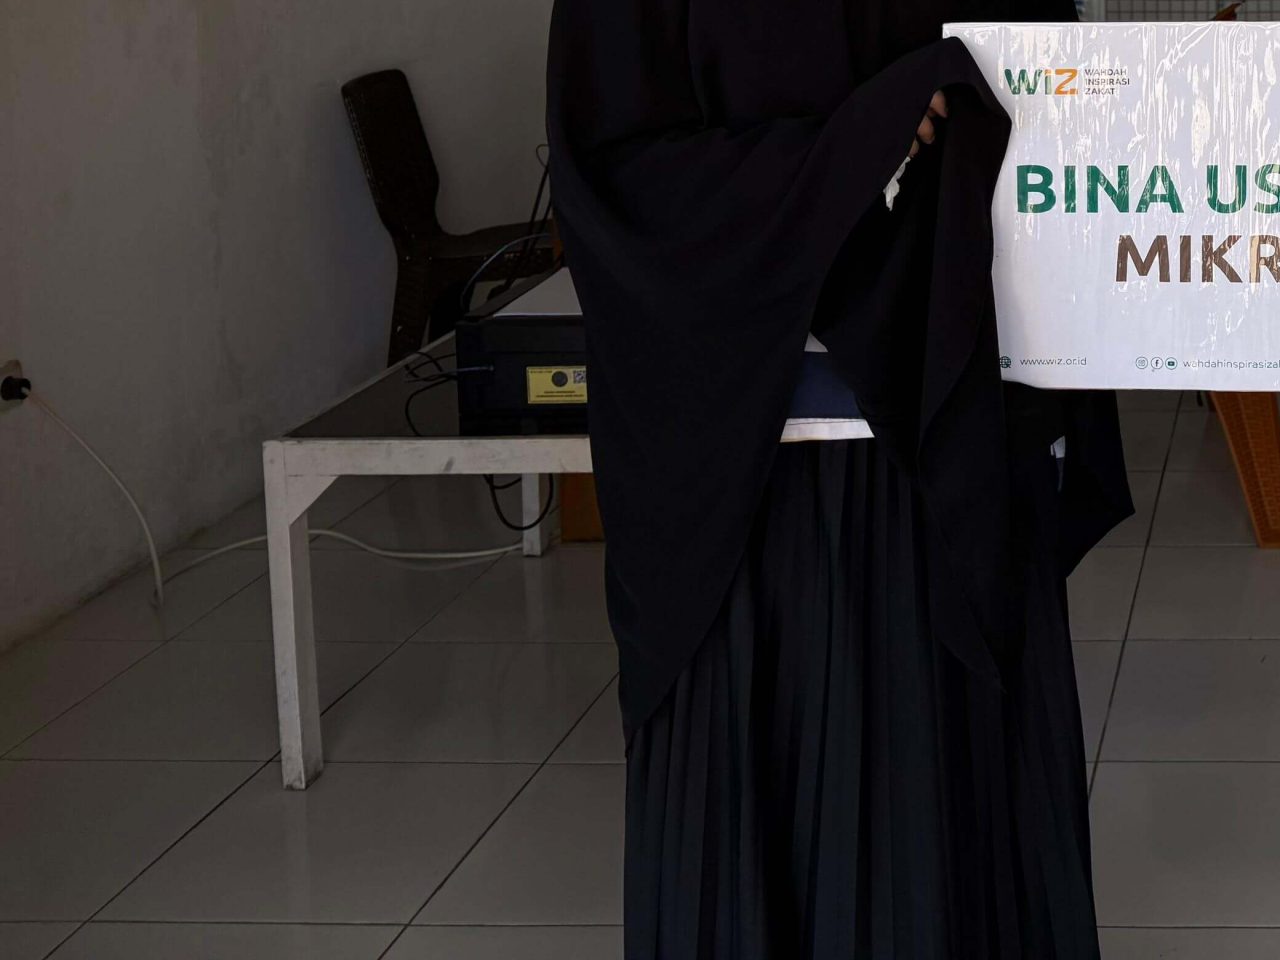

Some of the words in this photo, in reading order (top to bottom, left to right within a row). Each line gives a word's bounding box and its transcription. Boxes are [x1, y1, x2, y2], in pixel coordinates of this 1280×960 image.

[1084, 68, 1127, 76] WAHDAH
[1084, 78, 1130, 86] INSPIRASI
[1084, 87, 1116, 95] ZAKAT
[1016, 164, 1185, 214] BINA
[1019, 356, 1087, 366] www.wiz.or.id
